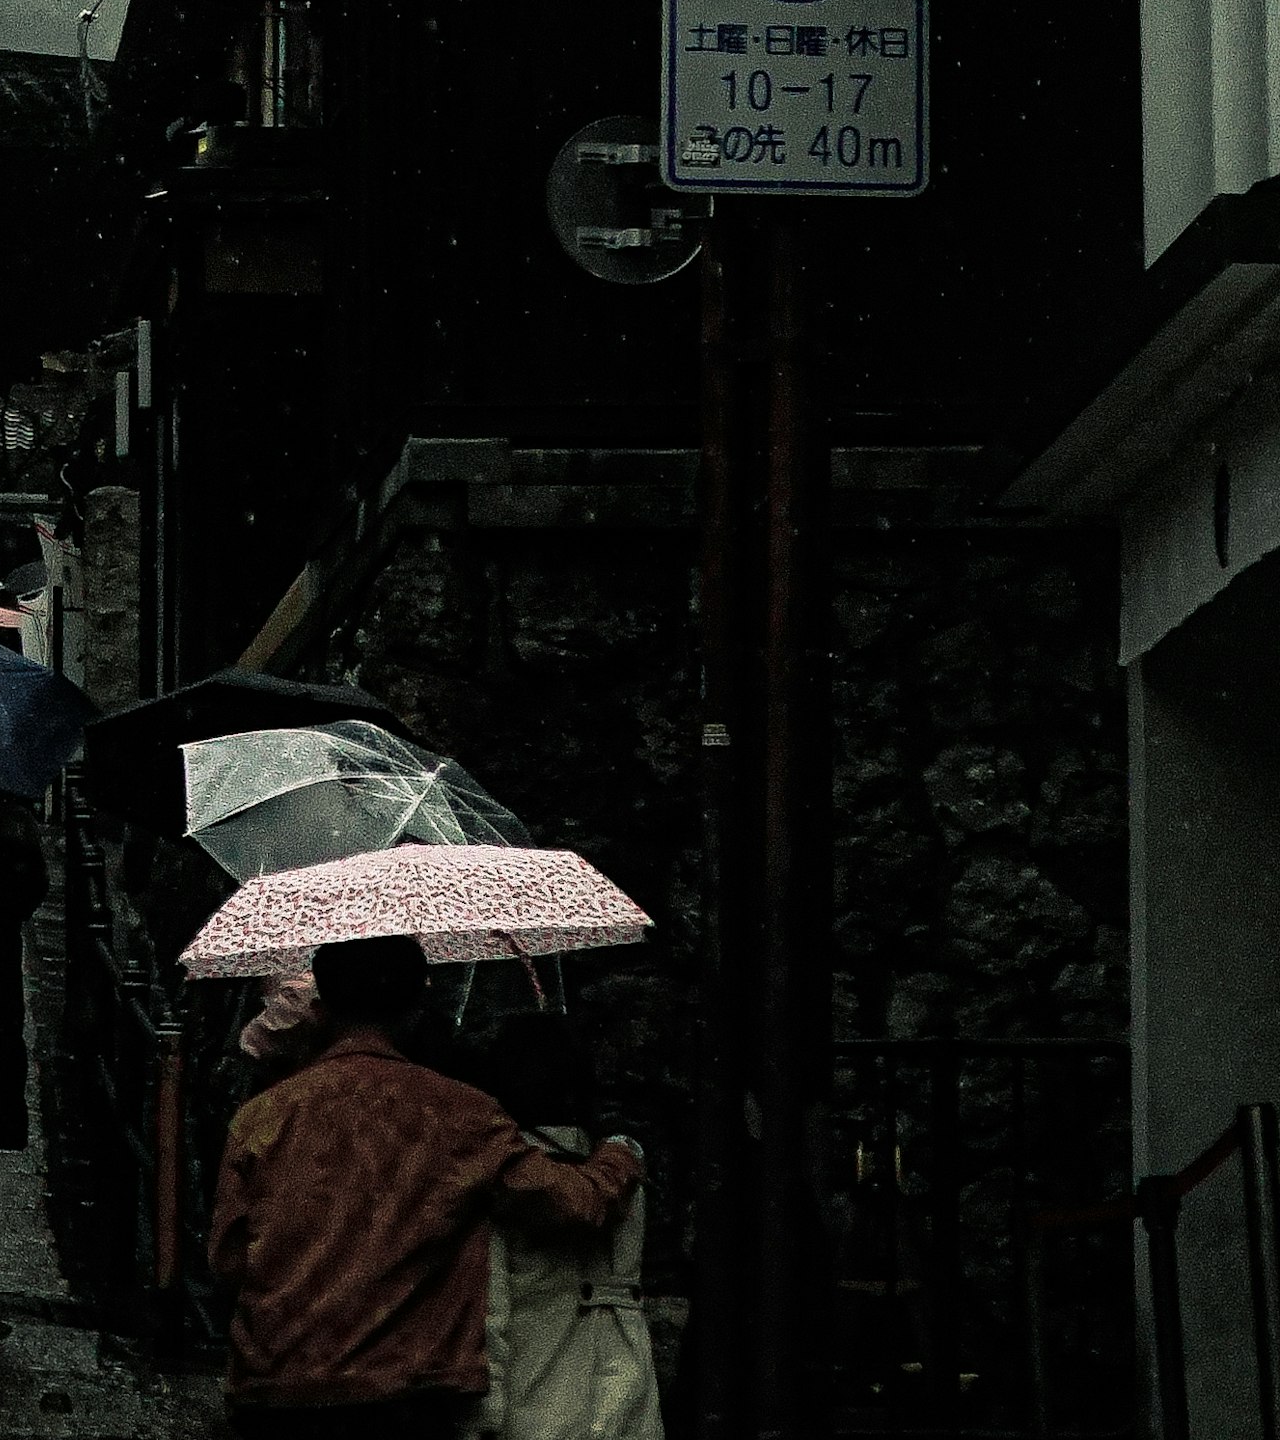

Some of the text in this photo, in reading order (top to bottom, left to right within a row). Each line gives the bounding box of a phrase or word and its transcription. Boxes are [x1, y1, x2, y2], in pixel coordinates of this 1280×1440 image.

[685, 24, 910, 59] 土曜・日曜・休日
[694, 124, 787, 166] の先
[808, 128, 903, 169] 40m
